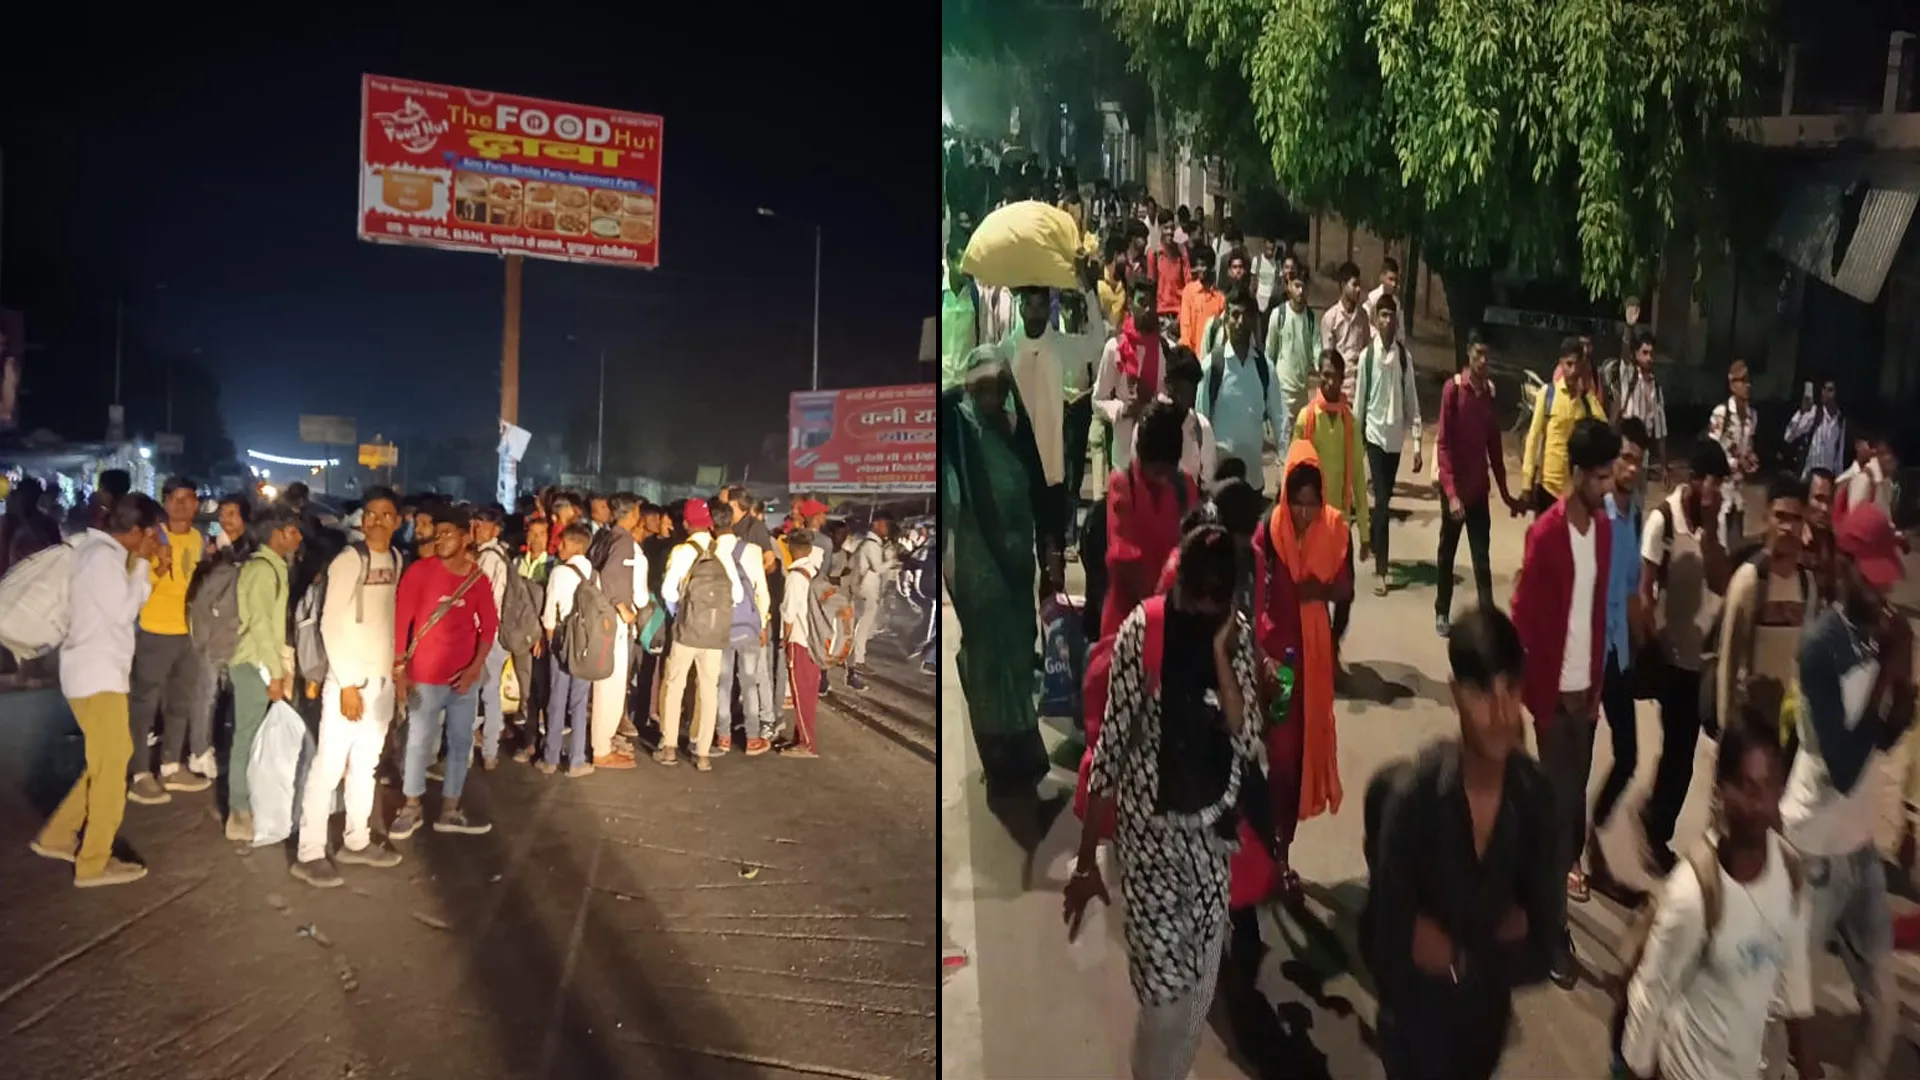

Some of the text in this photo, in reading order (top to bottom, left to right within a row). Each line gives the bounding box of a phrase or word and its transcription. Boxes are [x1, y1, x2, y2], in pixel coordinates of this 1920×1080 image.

[447, 104, 492, 129] The
[494, 104, 609, 145] FOOD
[614, 128, 654, 151] Hut
